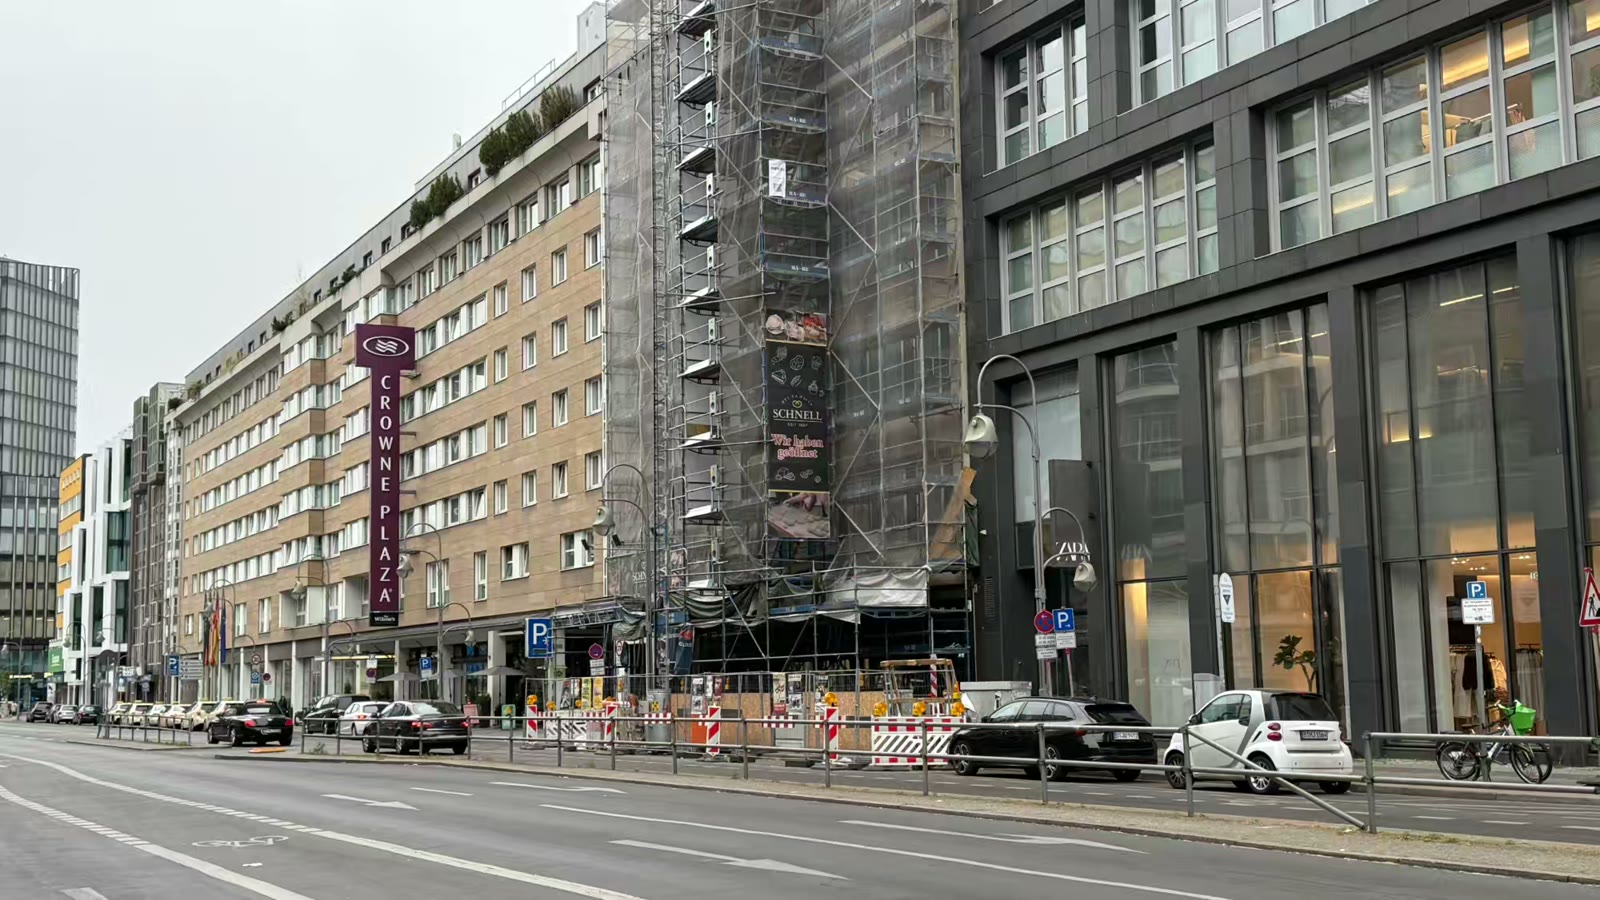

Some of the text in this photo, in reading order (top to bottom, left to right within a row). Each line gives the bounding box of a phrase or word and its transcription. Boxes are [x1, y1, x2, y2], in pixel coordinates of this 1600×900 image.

[772, 408, 822, 420] SCHNELL
[771, 433, 824, 448] Wir haben
[777, 447, 818, 460] geöffnet
[378, 375, 394, 603] CROWNE PLAZA
[1055, 541, 1091, 562] ZARA
[1471, 583, 1481, 598] P
[1057, 612, 1069, 628] P
[533, 623, 548, 645] P
